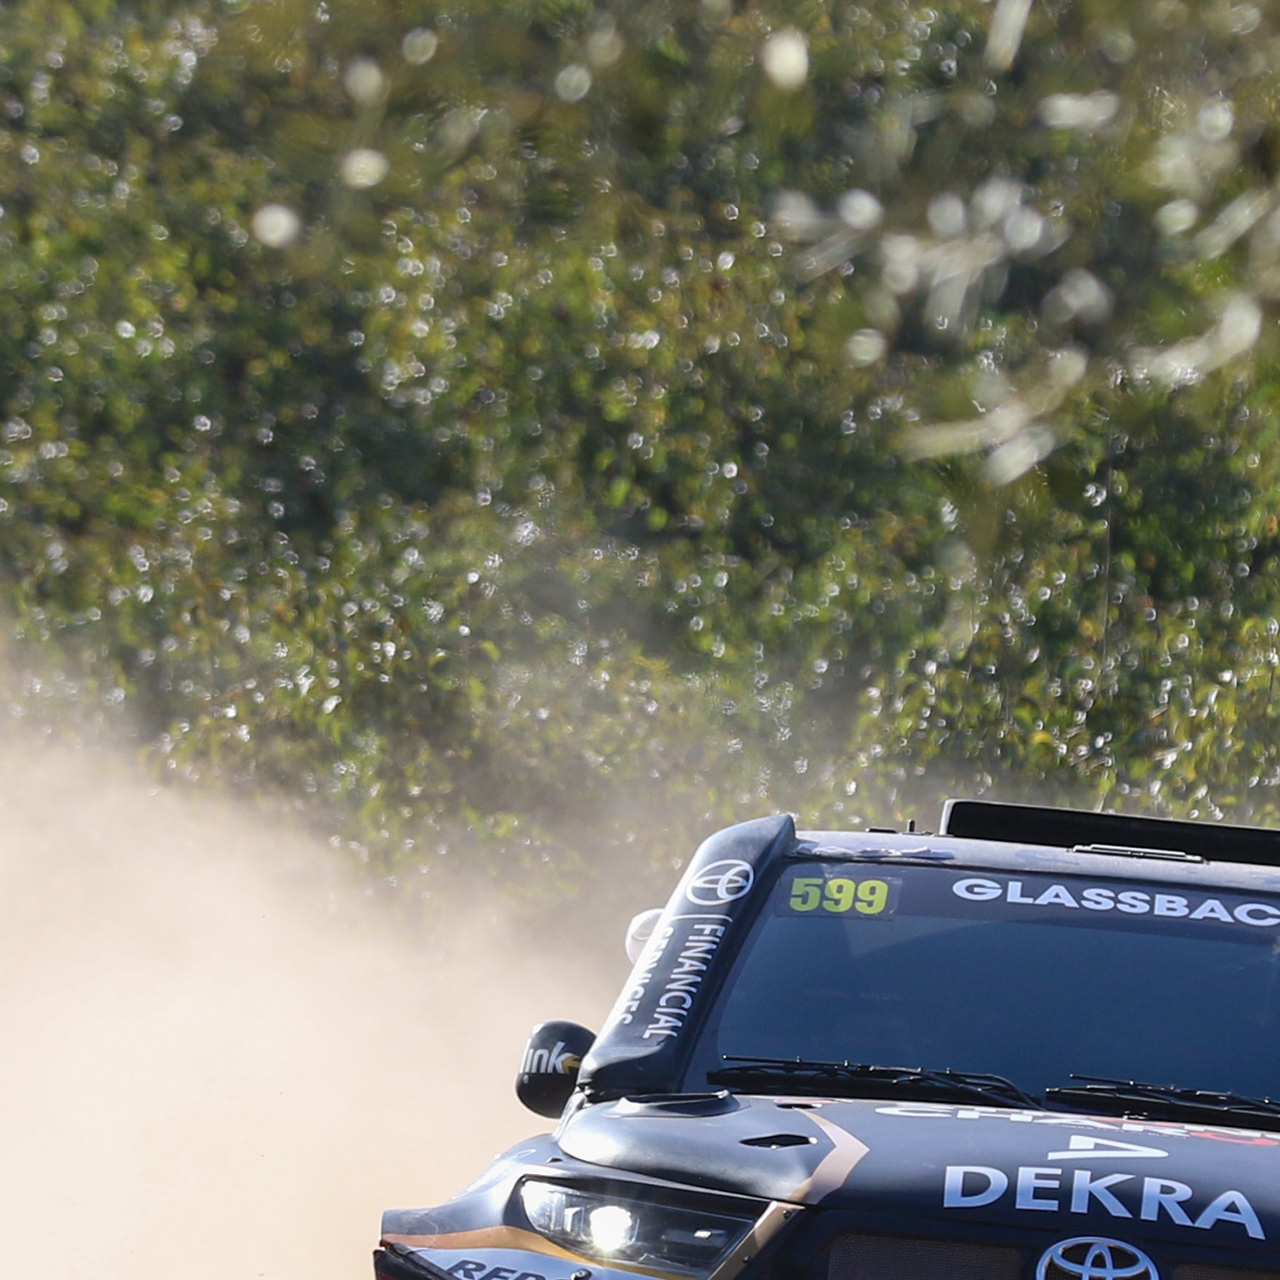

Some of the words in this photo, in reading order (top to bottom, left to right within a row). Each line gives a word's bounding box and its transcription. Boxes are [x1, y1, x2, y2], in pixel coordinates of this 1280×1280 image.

[789, 876, 889, 916] 599
[642, 923, 726, 1039] FINANCIAL
[942, 1165, 1266, 1240] DEKRA
